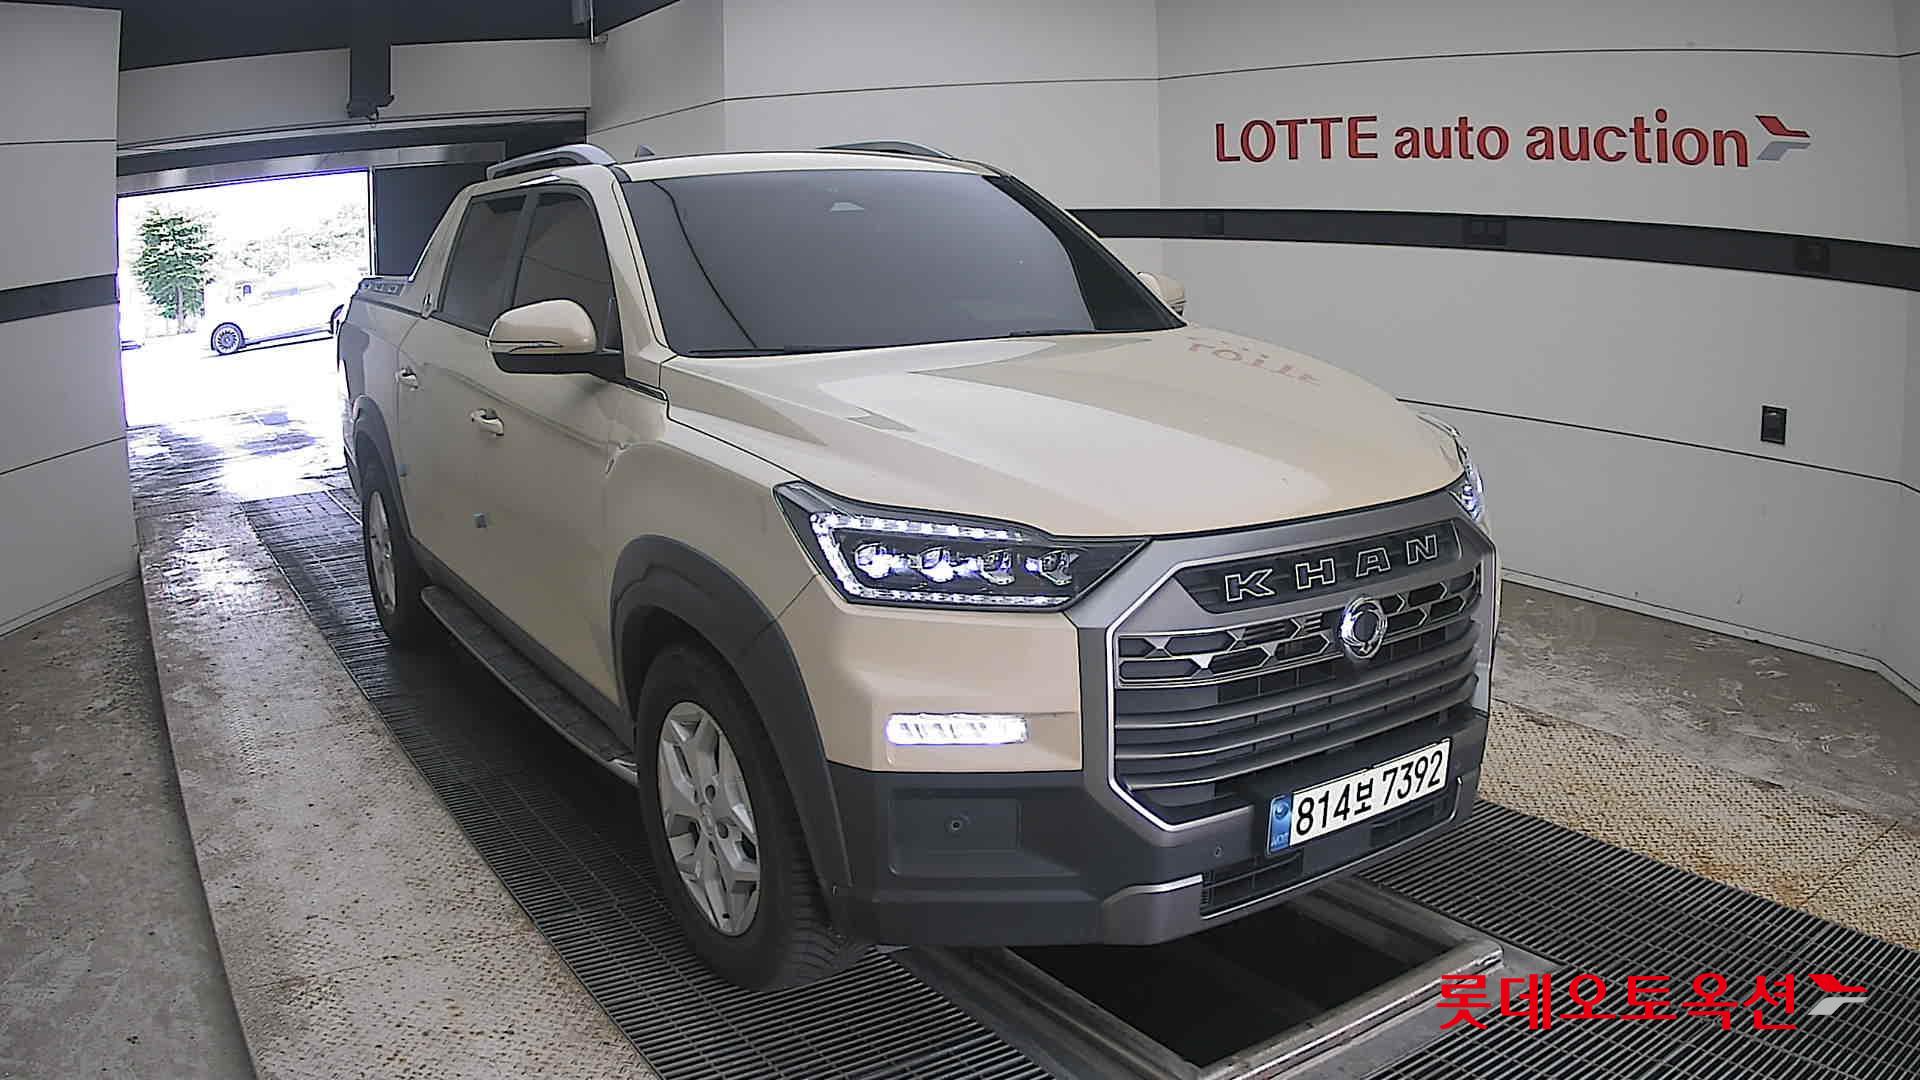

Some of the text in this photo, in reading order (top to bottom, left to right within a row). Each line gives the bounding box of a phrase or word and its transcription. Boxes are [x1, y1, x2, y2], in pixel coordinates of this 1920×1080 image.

[1215, 108, 1749, 167] LOTTE auto auction
[1225, 534, 1439, 601] KHAN
[1382, 750, 1443, 806] 7392
